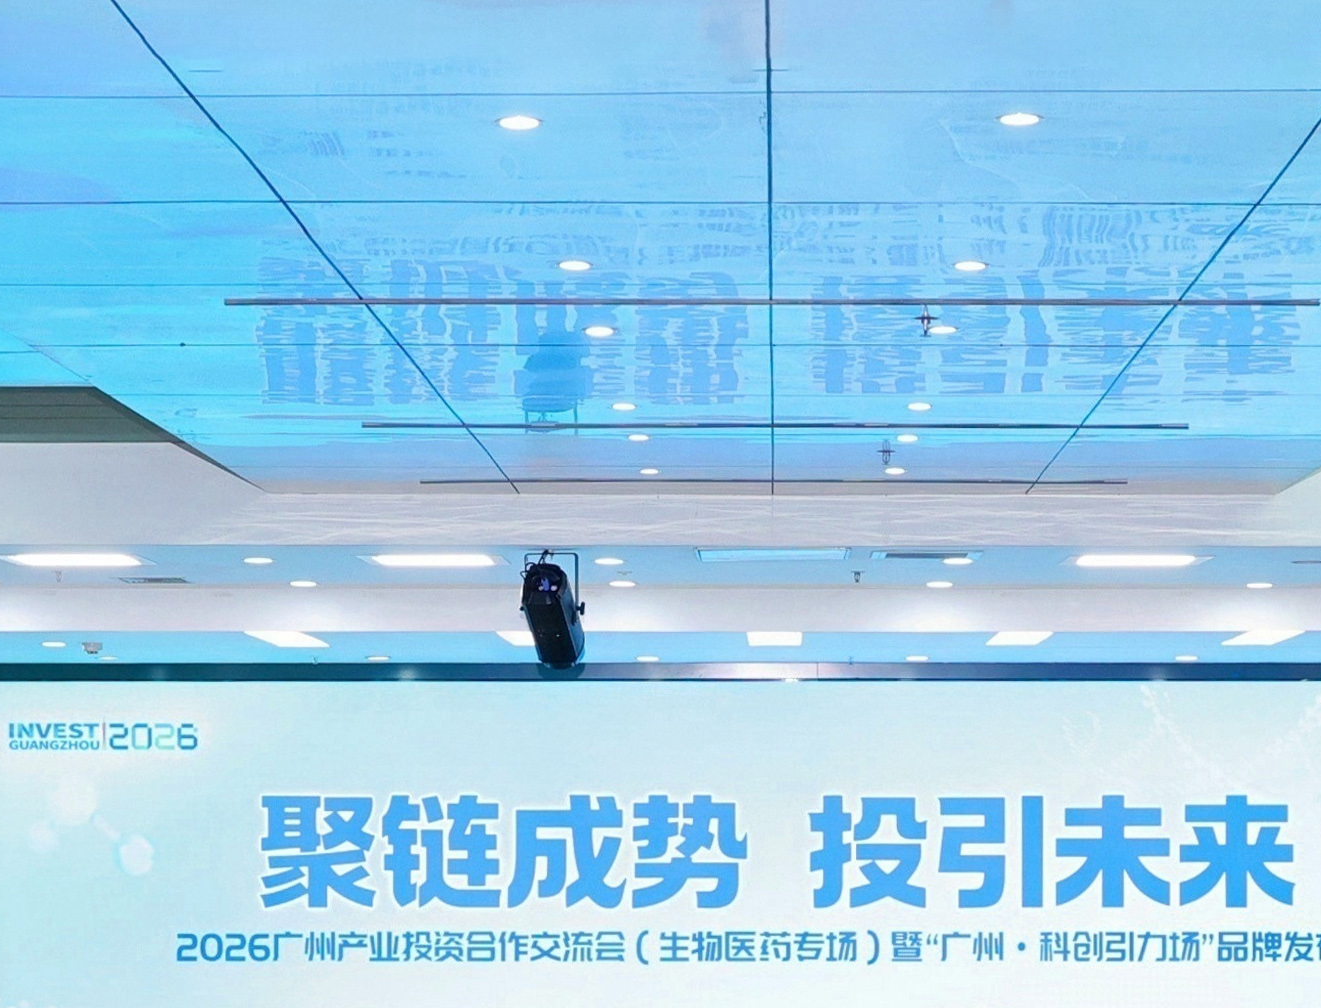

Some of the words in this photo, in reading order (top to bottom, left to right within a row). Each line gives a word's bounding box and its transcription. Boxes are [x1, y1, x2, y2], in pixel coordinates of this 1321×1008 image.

[9, 723, 99, 738] INVEST
[109, 723, 198, 750] 2026
[9, 740, 100, 750] GUANGZHOU
[260, 794, 748, 909] 聚链成势
[808, 794, 1296, 909] 投引未来
